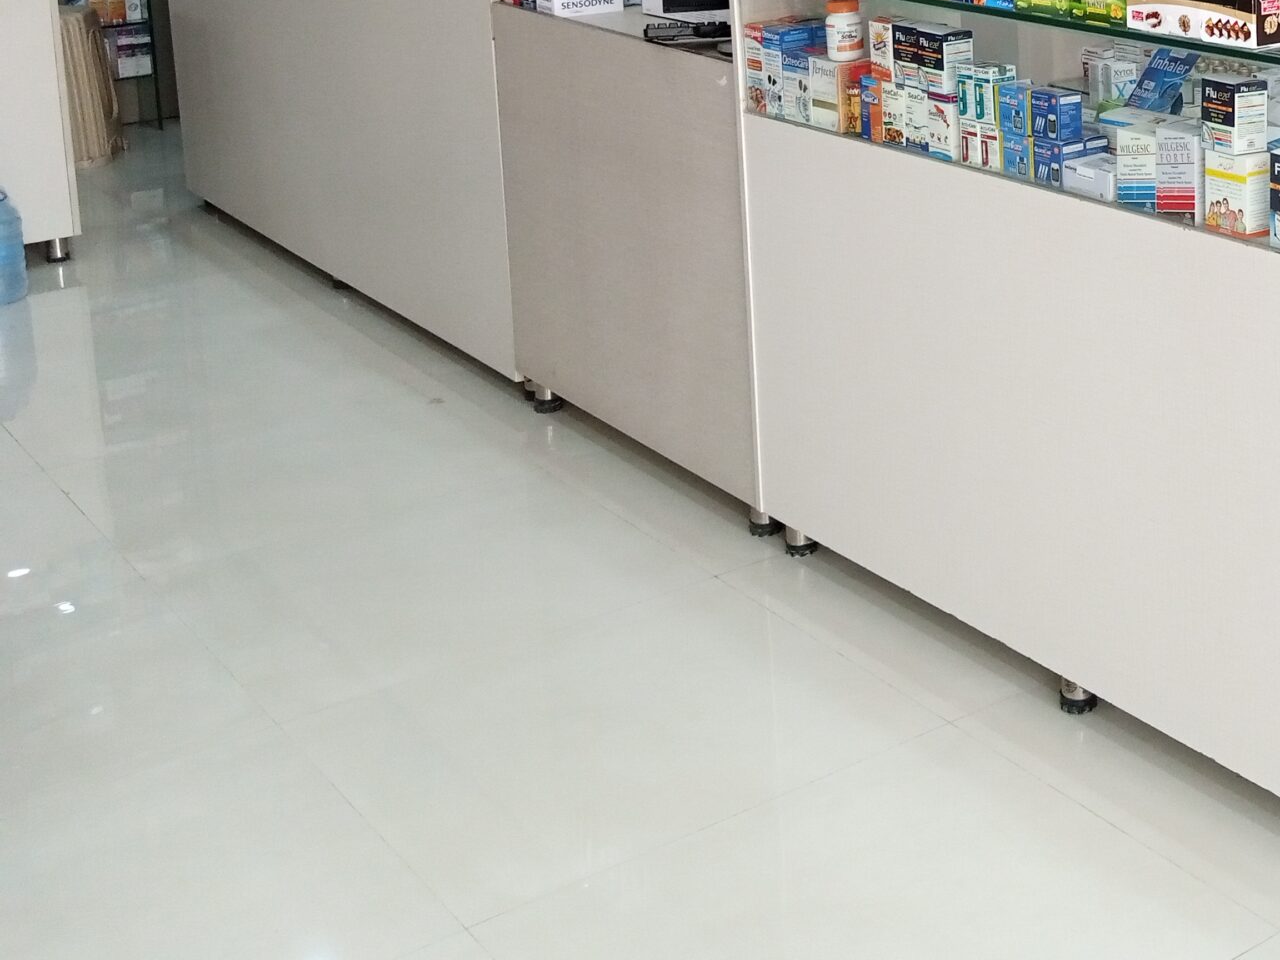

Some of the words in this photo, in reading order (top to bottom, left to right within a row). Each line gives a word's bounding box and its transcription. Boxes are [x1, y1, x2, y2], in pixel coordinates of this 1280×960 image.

[895, 31, 905, 41] Flu
[919, 37, 929, 47] Flu
[782, 54, 809, 70] Osteocare
[1153, 56, 1190, 75] Inhaler
[1205, 87, 1217, 99] Flu
[1119, 144, 1151, 154] WILGESIC
[1158, 141, 1191, 152] WILGESIC
[1160, 154, 1192, 164] FORTE
